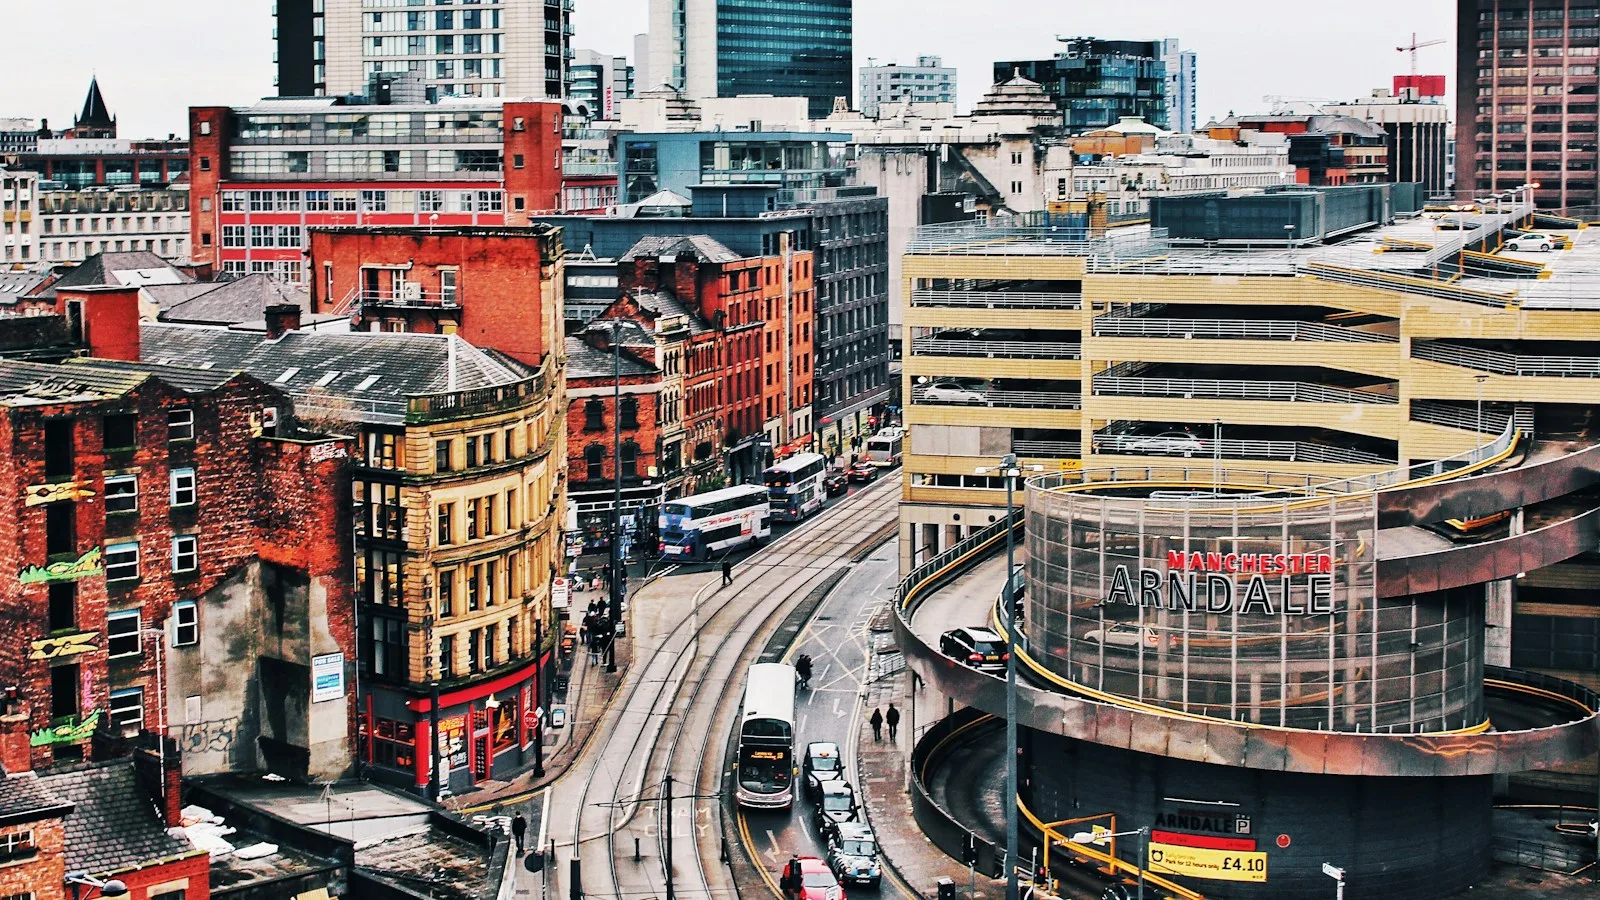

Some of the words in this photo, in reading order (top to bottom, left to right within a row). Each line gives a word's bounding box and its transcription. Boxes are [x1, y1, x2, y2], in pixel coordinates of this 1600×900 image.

[1168, 550, 1331, 573] MANCHESTER
[1107, 564, 1331, 615] ARNDALE
[1154, 812, 1232, 833] ARNDALE
[1222, 857, 1264, 872] £4.10
